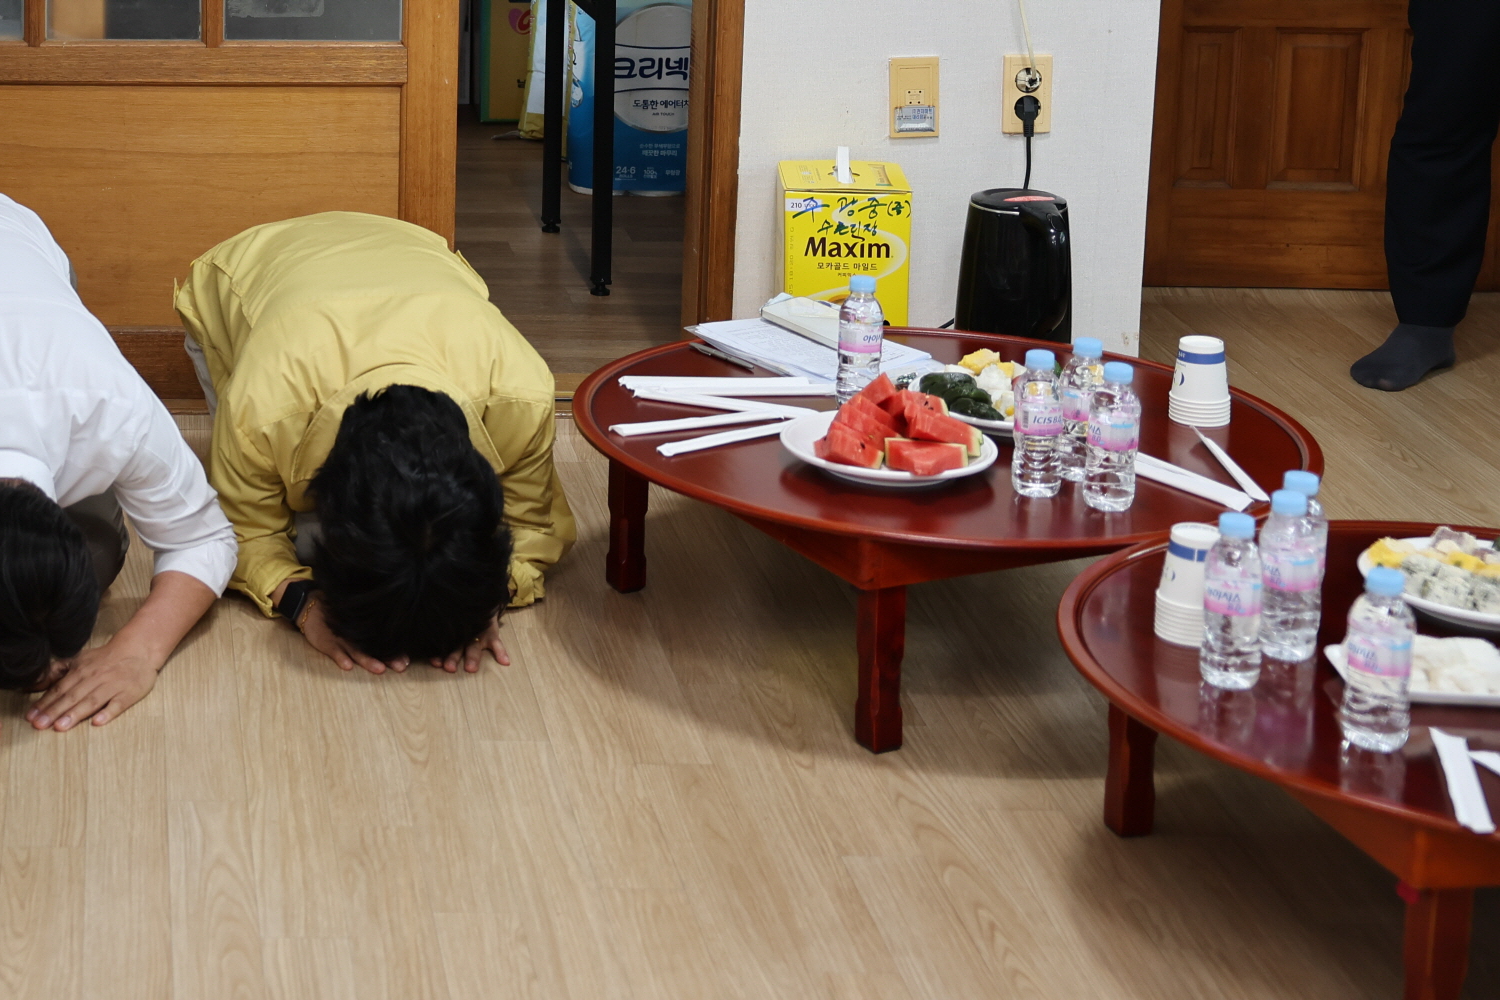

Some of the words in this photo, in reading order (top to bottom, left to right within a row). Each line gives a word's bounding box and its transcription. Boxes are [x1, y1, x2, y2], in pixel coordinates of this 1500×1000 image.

[633, 100, 658, 109] 도톰한
[804, 234, 890, 258] Maxim
[853, 263, 877, 271] 마일드
